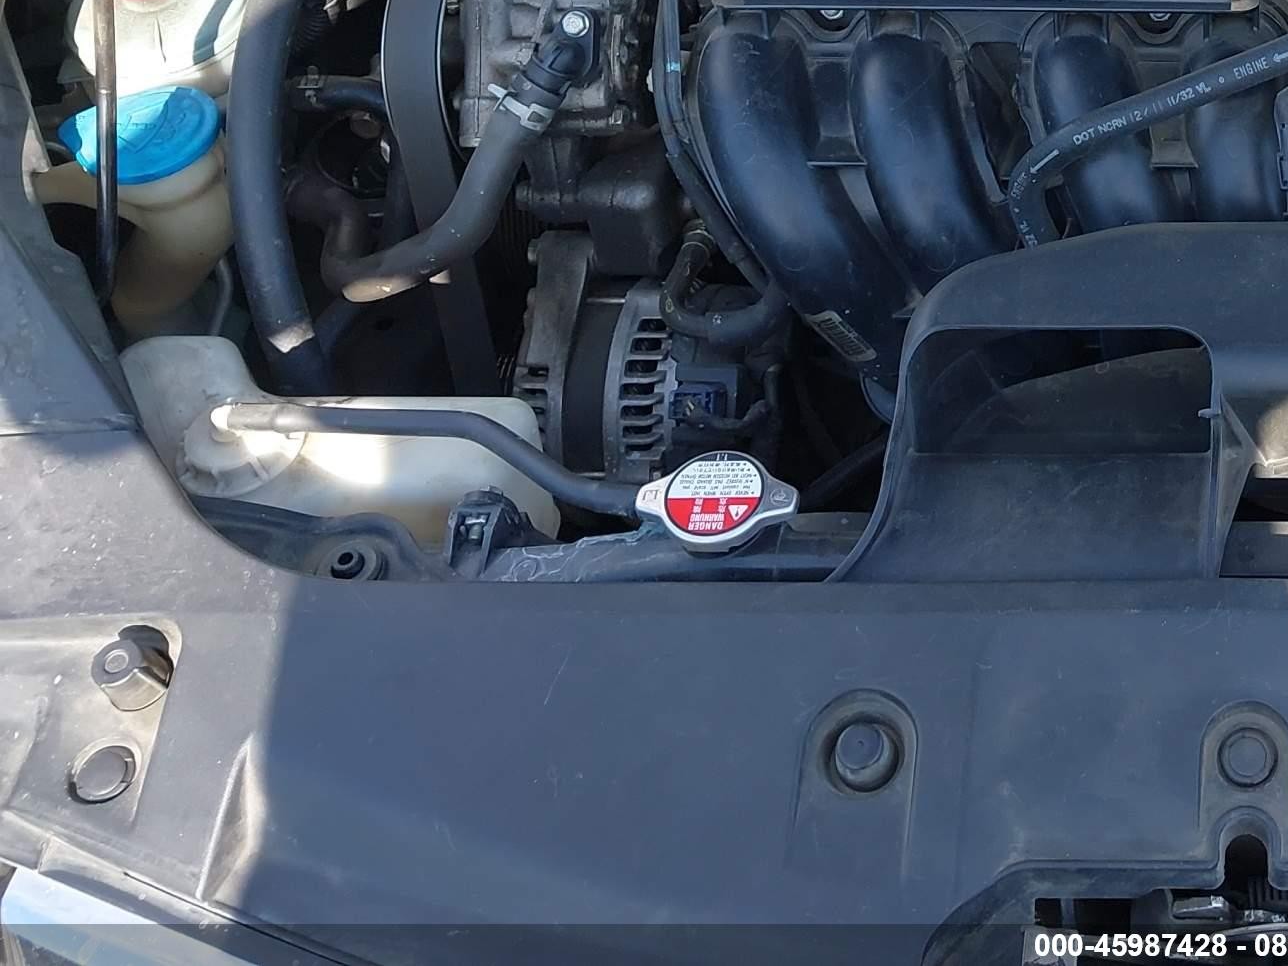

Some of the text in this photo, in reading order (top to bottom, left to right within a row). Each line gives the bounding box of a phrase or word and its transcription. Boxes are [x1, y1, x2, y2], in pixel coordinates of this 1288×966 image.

[1072, 130, 1097, 146] DOT
[1098, 116, 1128, 134] NCRN
[1233, 57, 1270, 80] ENGINE
[688, 522, 724, 530] DANGER
